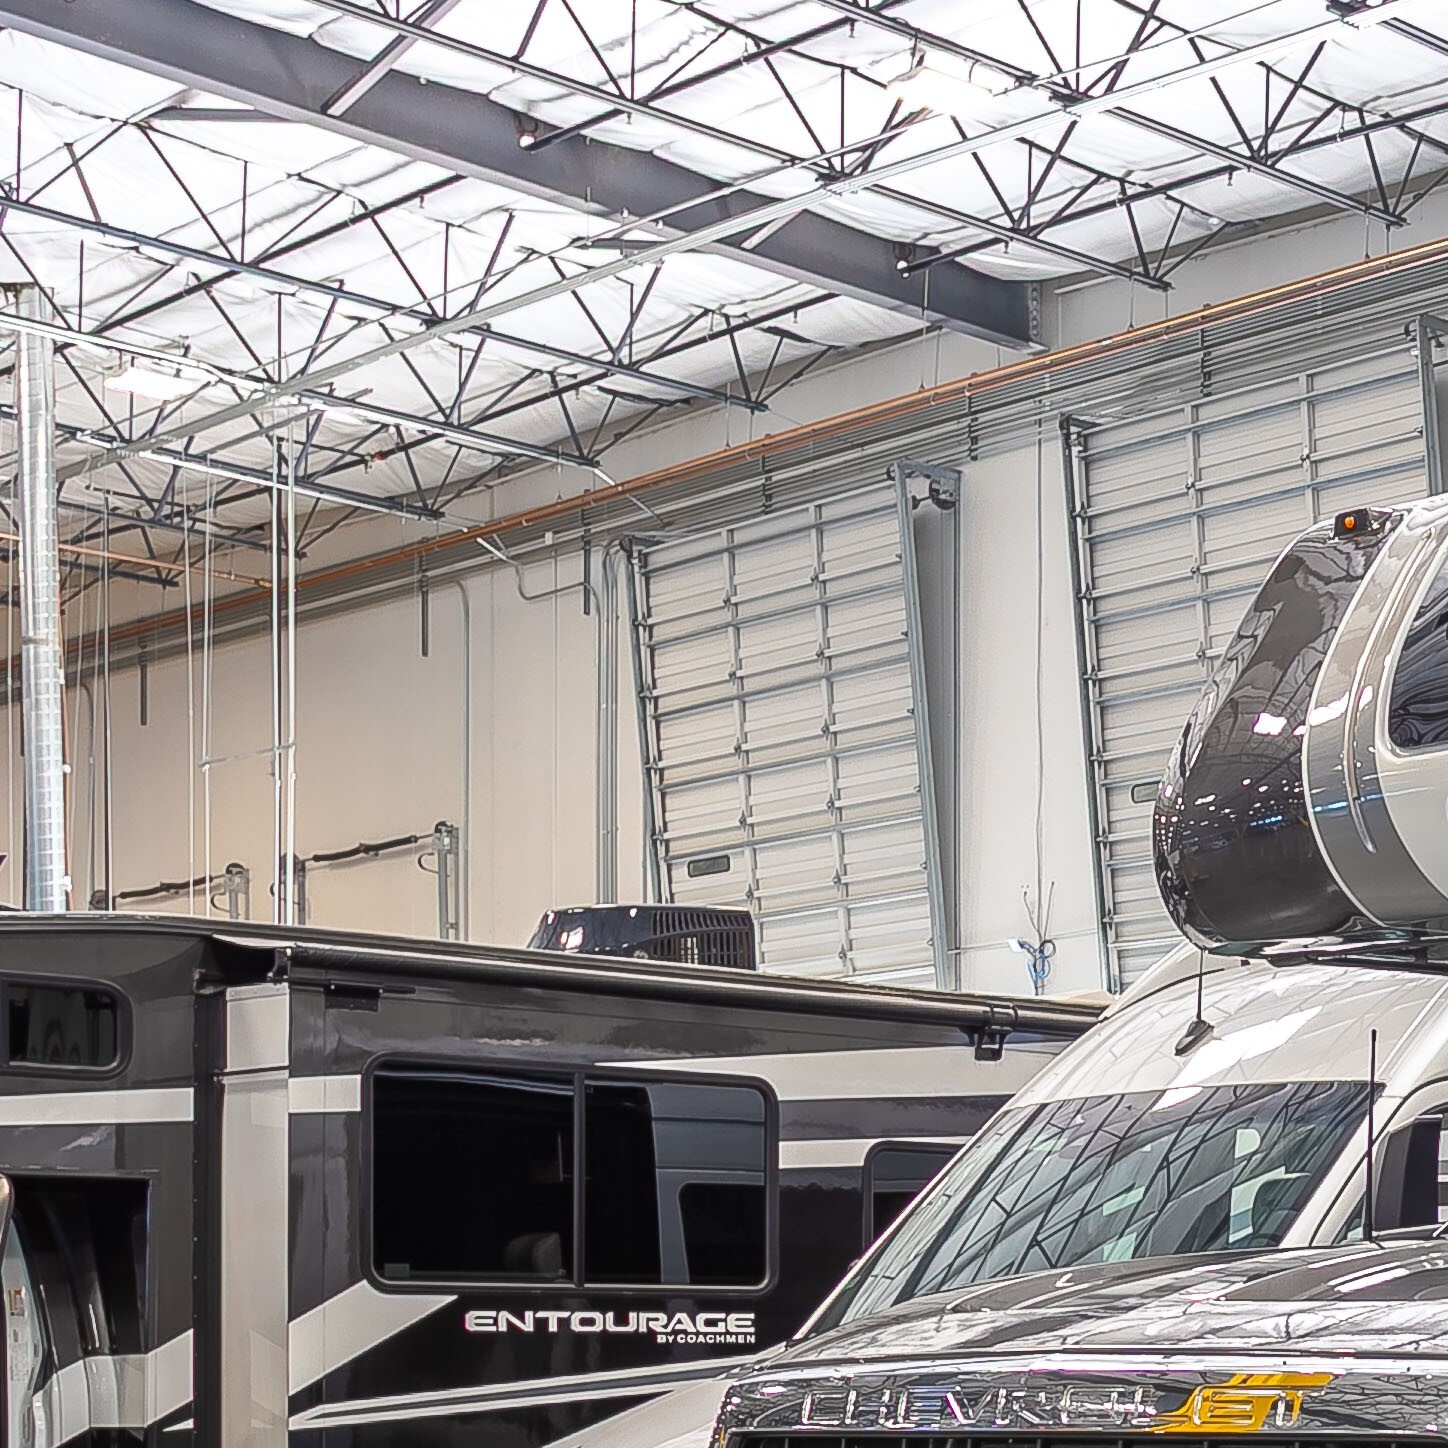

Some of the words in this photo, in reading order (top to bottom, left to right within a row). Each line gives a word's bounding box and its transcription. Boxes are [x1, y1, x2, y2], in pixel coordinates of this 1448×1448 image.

[464, 1310, 756, 1333] ENTOURAGE
[656, 1333, 674, 1344] BY
[676, 1333, 756, 1344] COACHMEN
